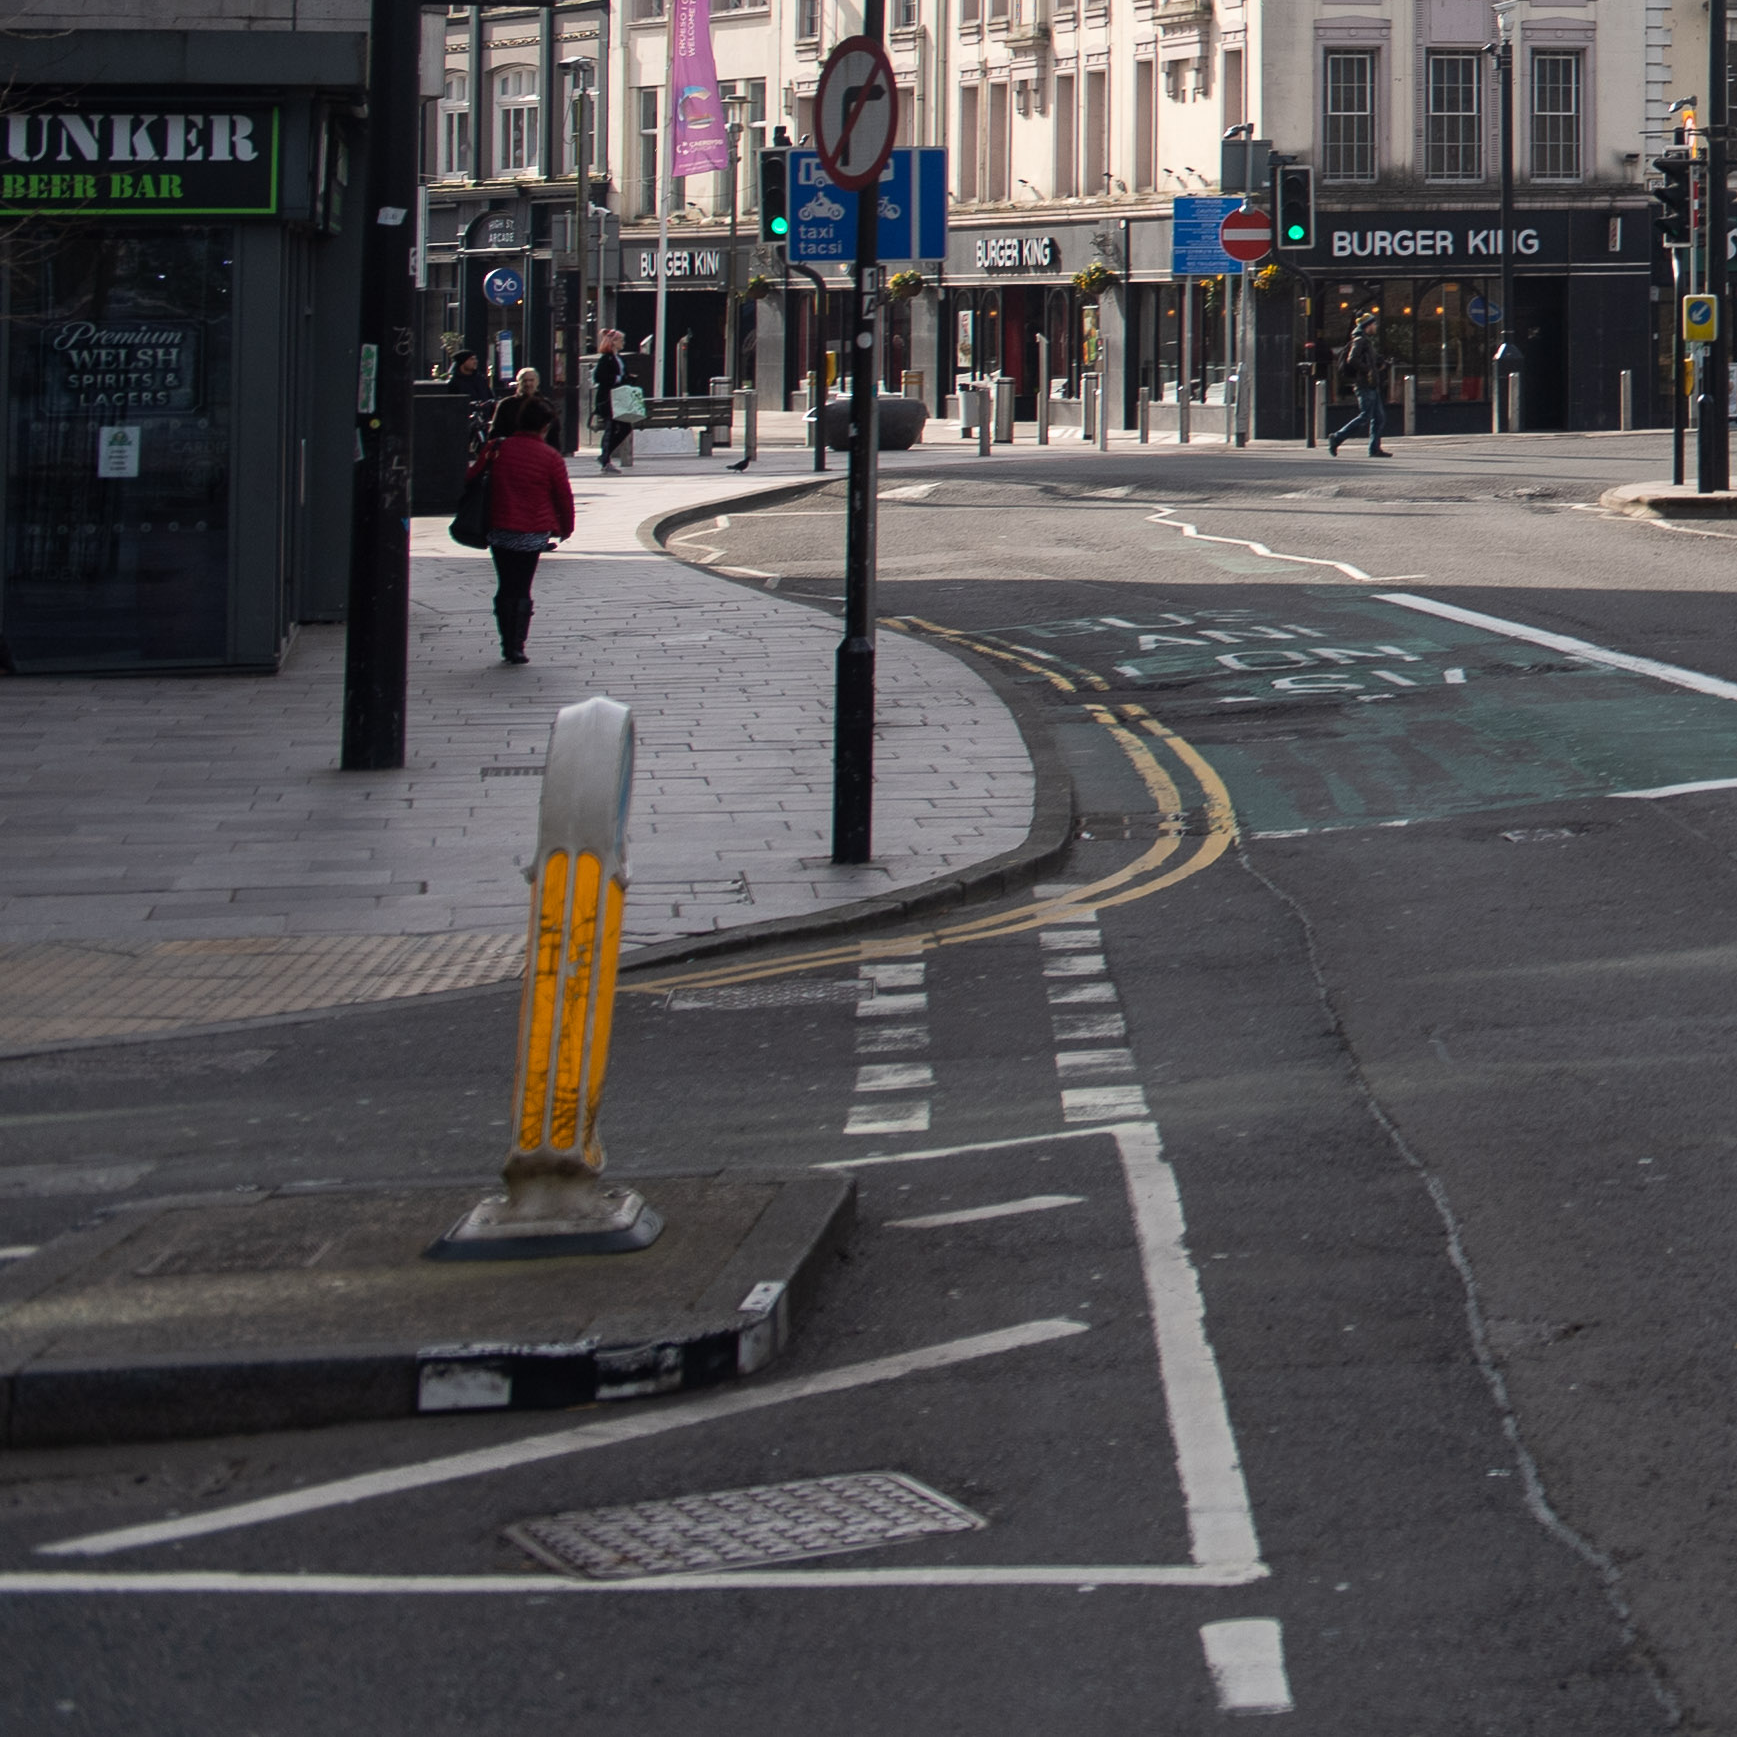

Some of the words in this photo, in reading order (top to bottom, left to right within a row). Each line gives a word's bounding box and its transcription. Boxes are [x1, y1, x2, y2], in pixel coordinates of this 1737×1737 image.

[7, 115, 259, 162] UNKER
[2, 174, 97, 198] BEER
[110, 174, 183, 198] BAR
[799, 224, 834, 239] taxi
[1333, 230, 1454, 257] BURGER
[799, 240, 842, 254] tacsi
[976, 239, 1019, 268] BURGER
[1023, 236, 1050, 266] KING
[640, 250, 690, 278] BUGER
[695, 251, 719, 275] KIN
[53, 321, 182, 350] Premium
[68, 348, 180, 369] WELSH
[68, 374, 151, 388] SPIRITS
[165, 373, 178, 387] &
